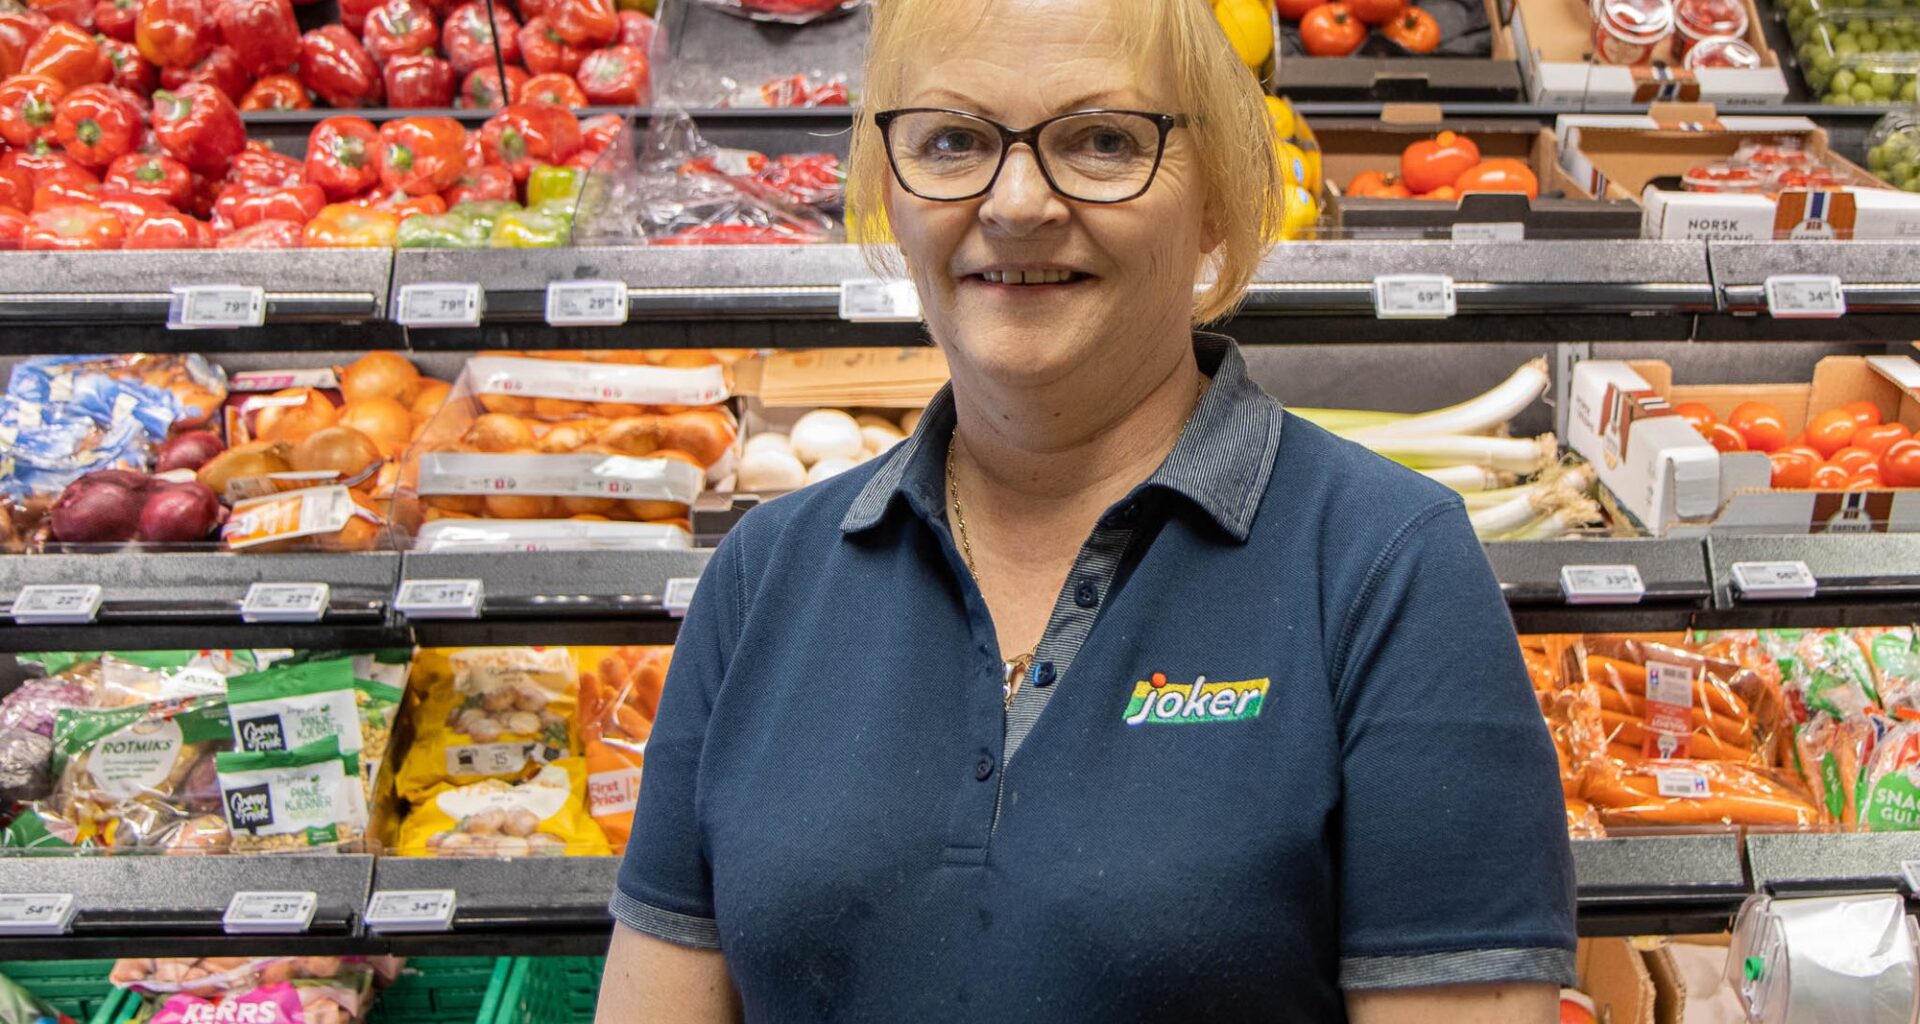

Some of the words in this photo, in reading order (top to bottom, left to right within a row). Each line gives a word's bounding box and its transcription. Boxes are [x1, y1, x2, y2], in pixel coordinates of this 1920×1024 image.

[1688, 219, 1739, 231] NORSK
[1126, 672, 1261, 726] joker
[101, 739, 173, 755] ROTMIKS
[590, 780, 618, 793] First
[590, 792, 625, 808] Price
[180, 1000, 277, 1023] KERRS
